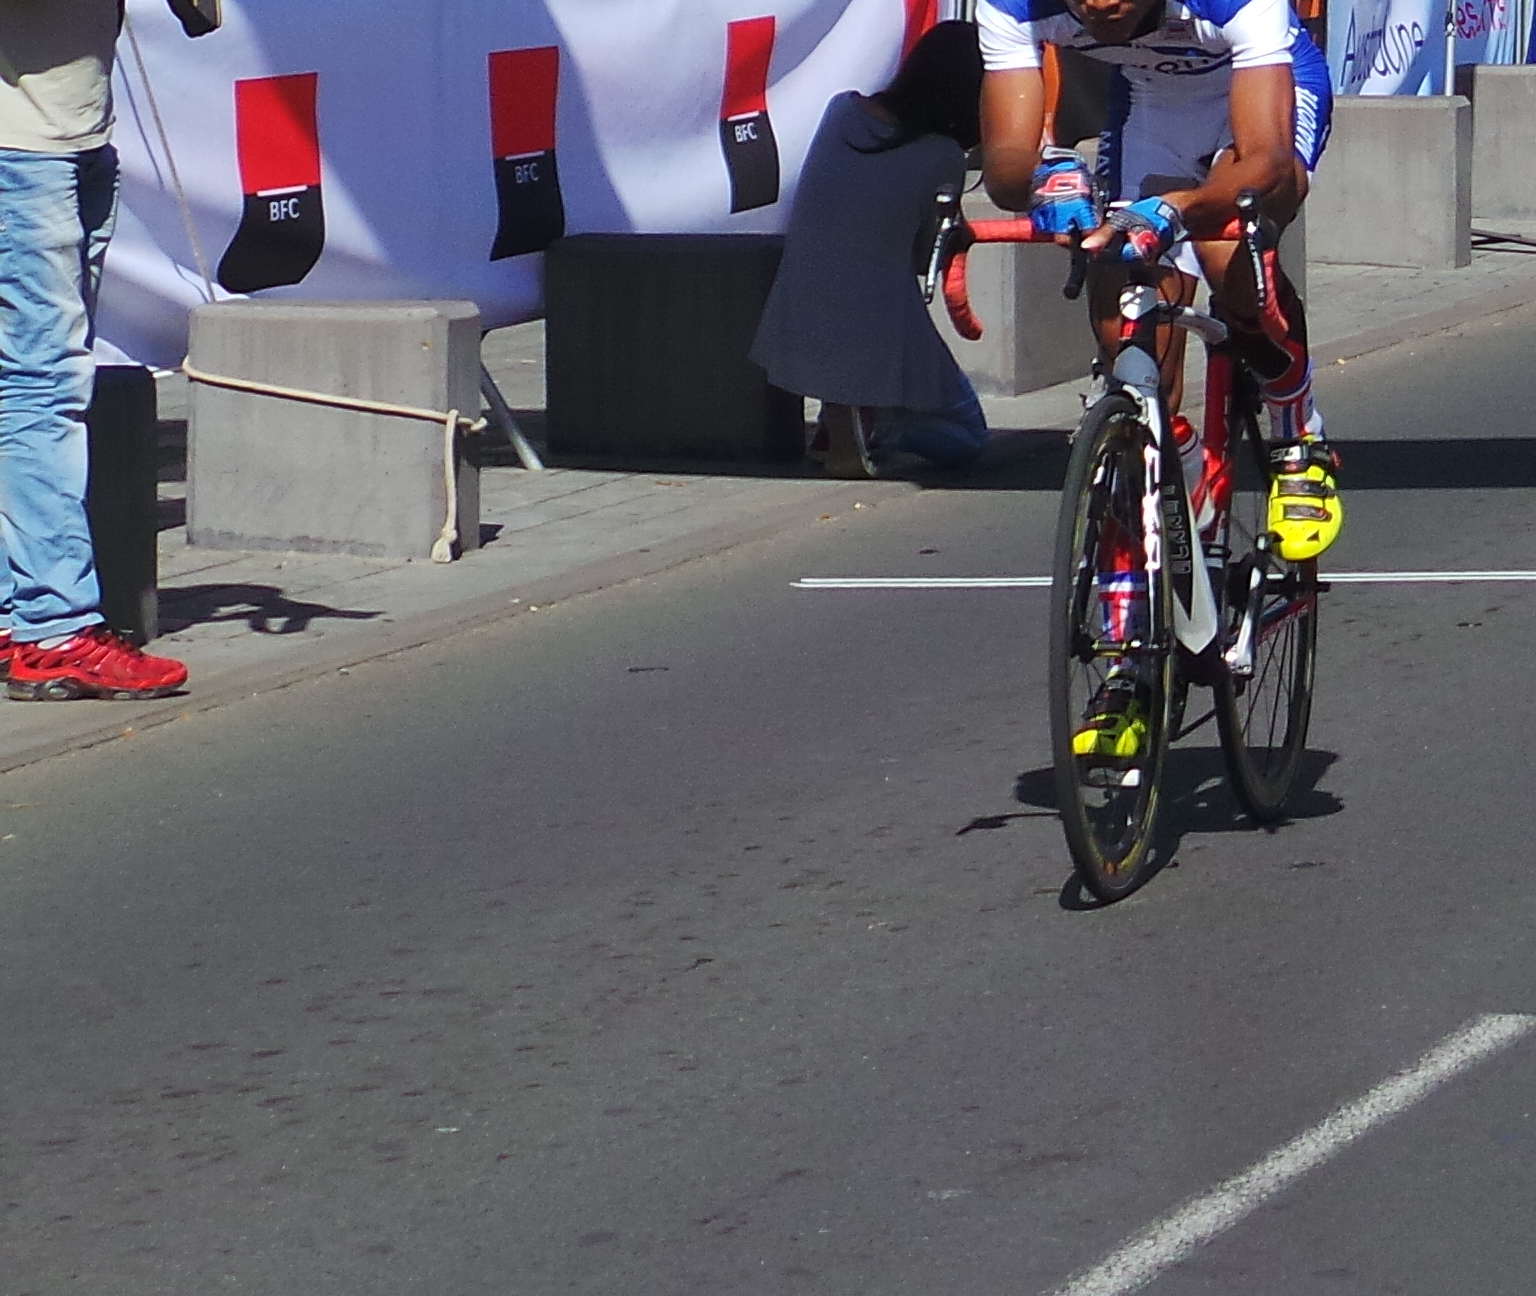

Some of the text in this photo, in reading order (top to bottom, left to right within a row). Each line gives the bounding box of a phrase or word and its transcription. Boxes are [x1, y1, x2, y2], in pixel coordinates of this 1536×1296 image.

[734, 122, 758, 142] BFC
[514, 163, 539, 183] BFC
[269, 197, 300, 221] BFC
